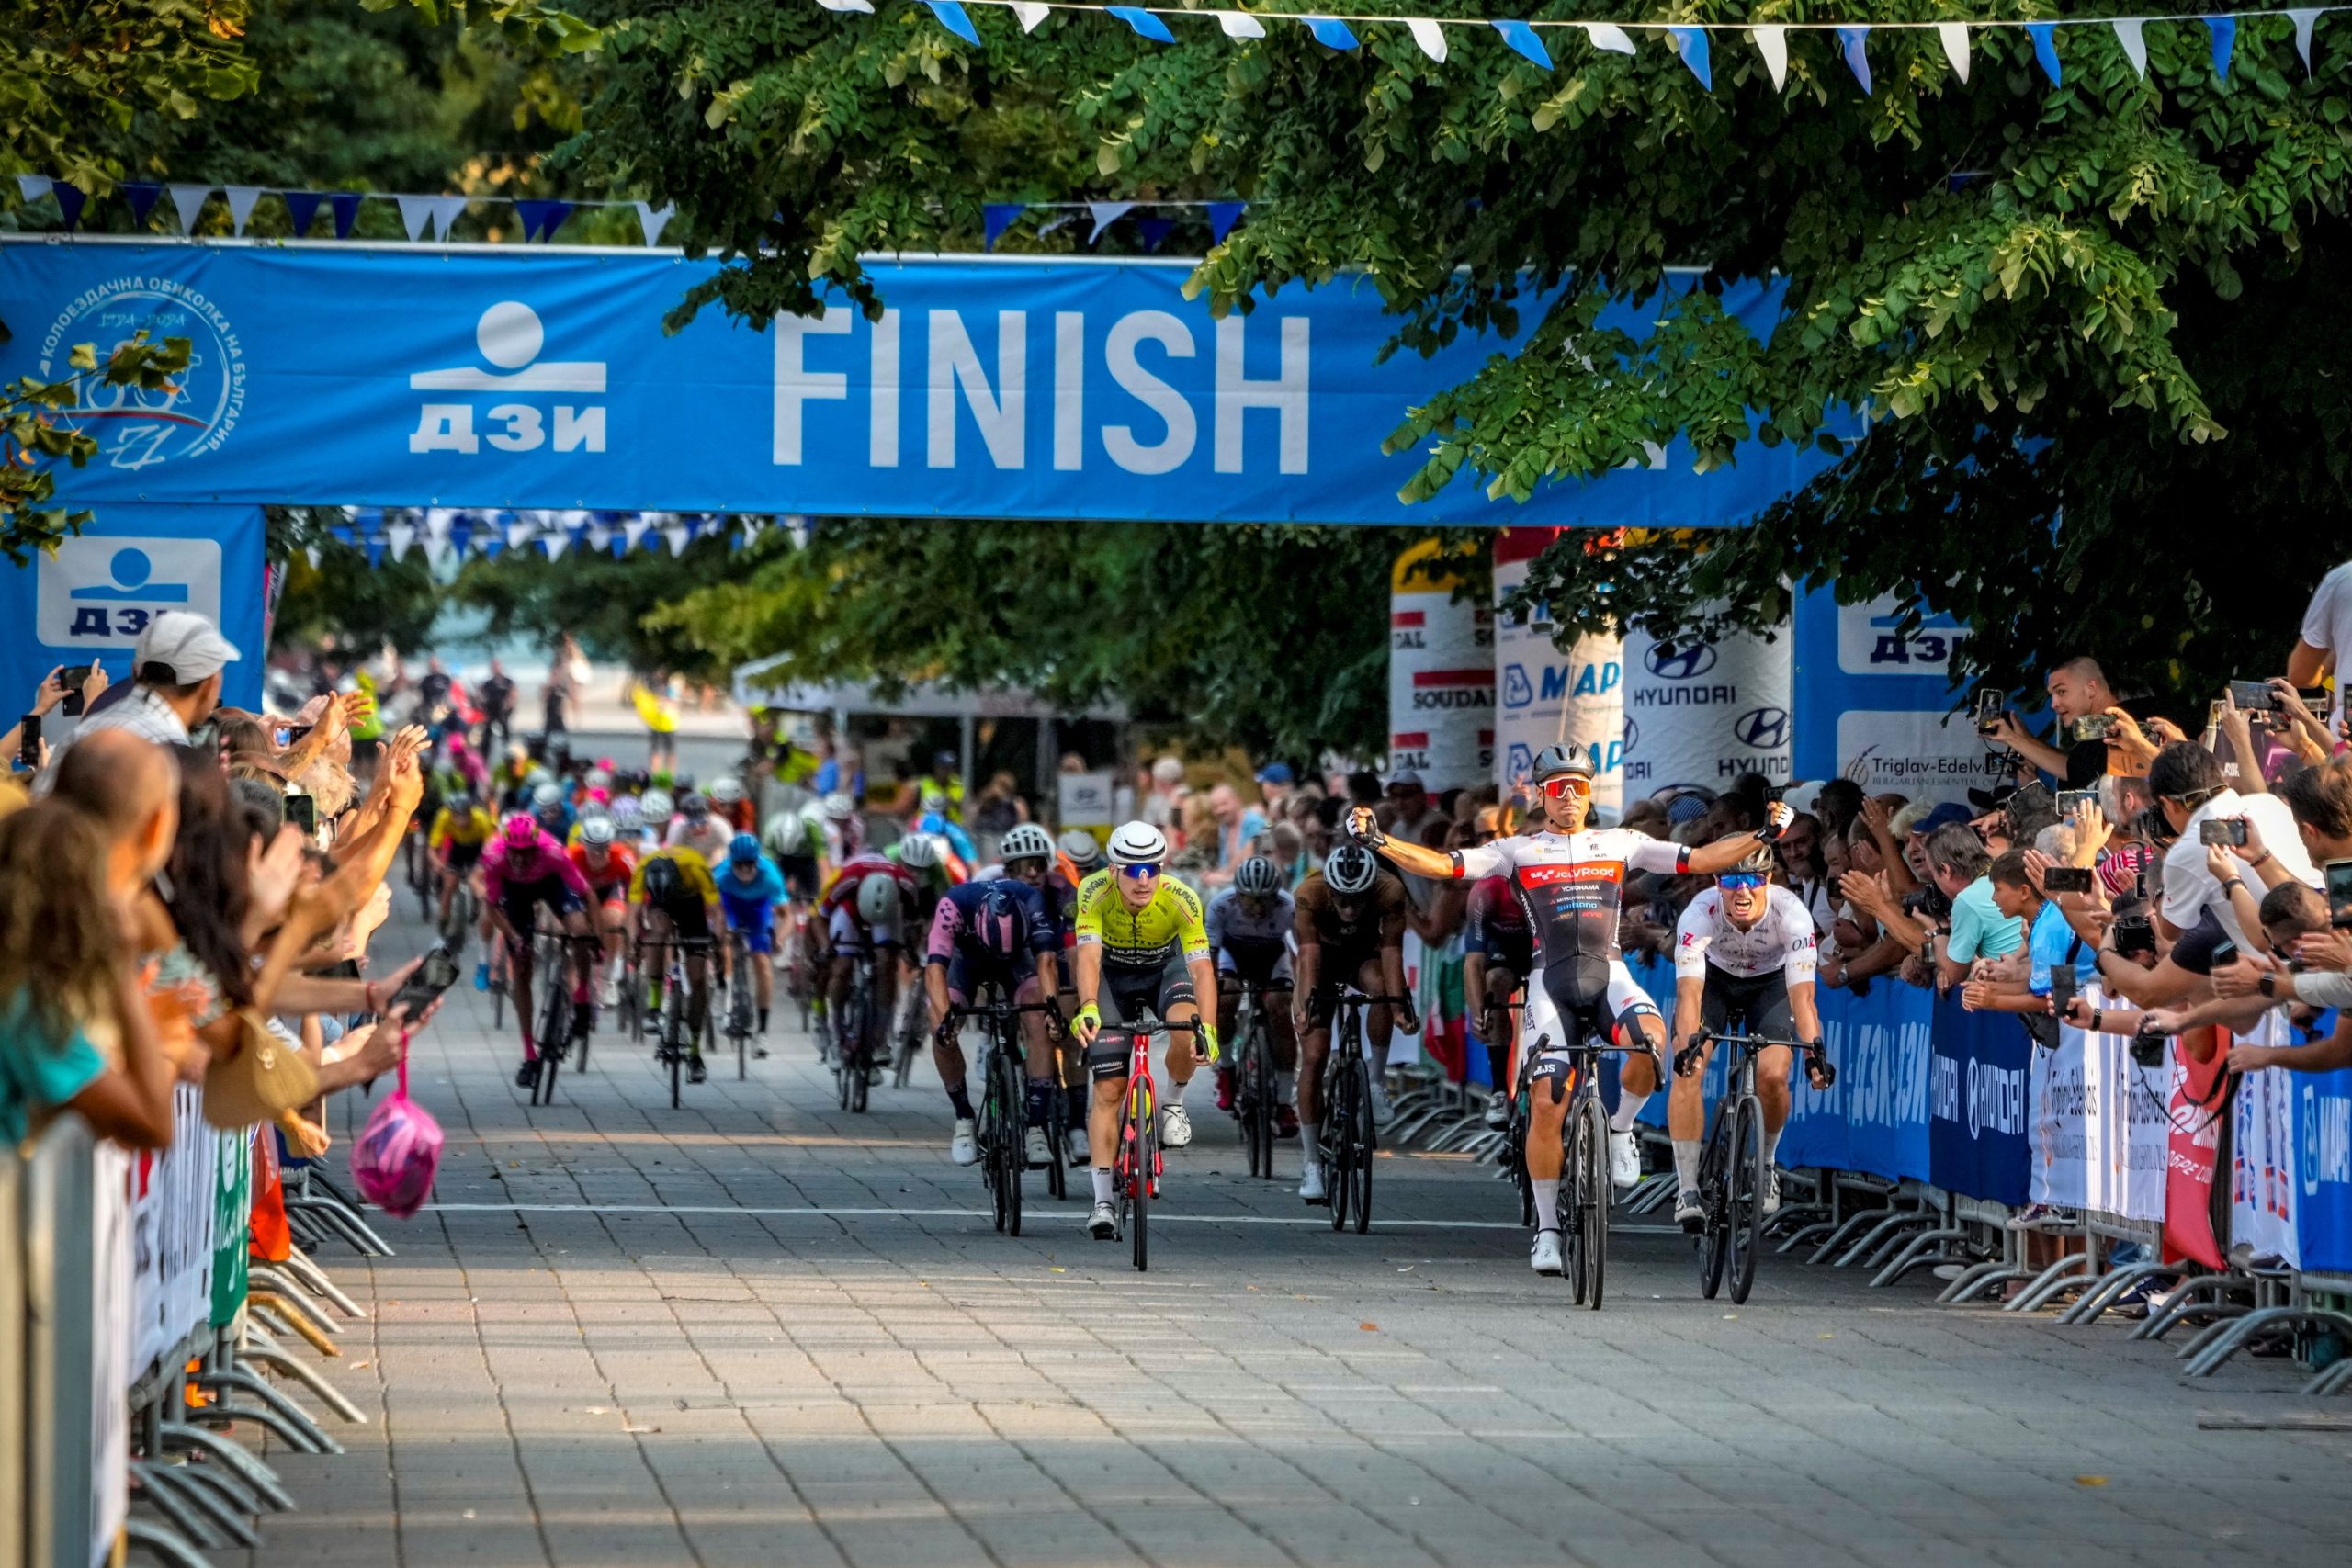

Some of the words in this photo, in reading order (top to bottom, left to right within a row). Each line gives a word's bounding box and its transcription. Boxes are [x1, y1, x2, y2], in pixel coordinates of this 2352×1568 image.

[41, 277, 145, 360] КОЛОЕЗДАЧНА
[224, 333, 243, 359] НА
[208, 362, 246, 452] БЪЛГАРИЯ
[773, 308, 1310, 475] FINISH
[409, 403, 606, 455] ДЗИ
[1634, 686, 1736, 707] HYUNDAI
[1083, 877, 1109, 903] HUNGARY
[1172, 886, 1200, 918] HUNGARY
[1562, 884, 1600, 892] YOKOHAMA
[1113, 943, 1171, 955] HUNGARY
[1980, 1062, 2025, 1135] HYUNDAI
